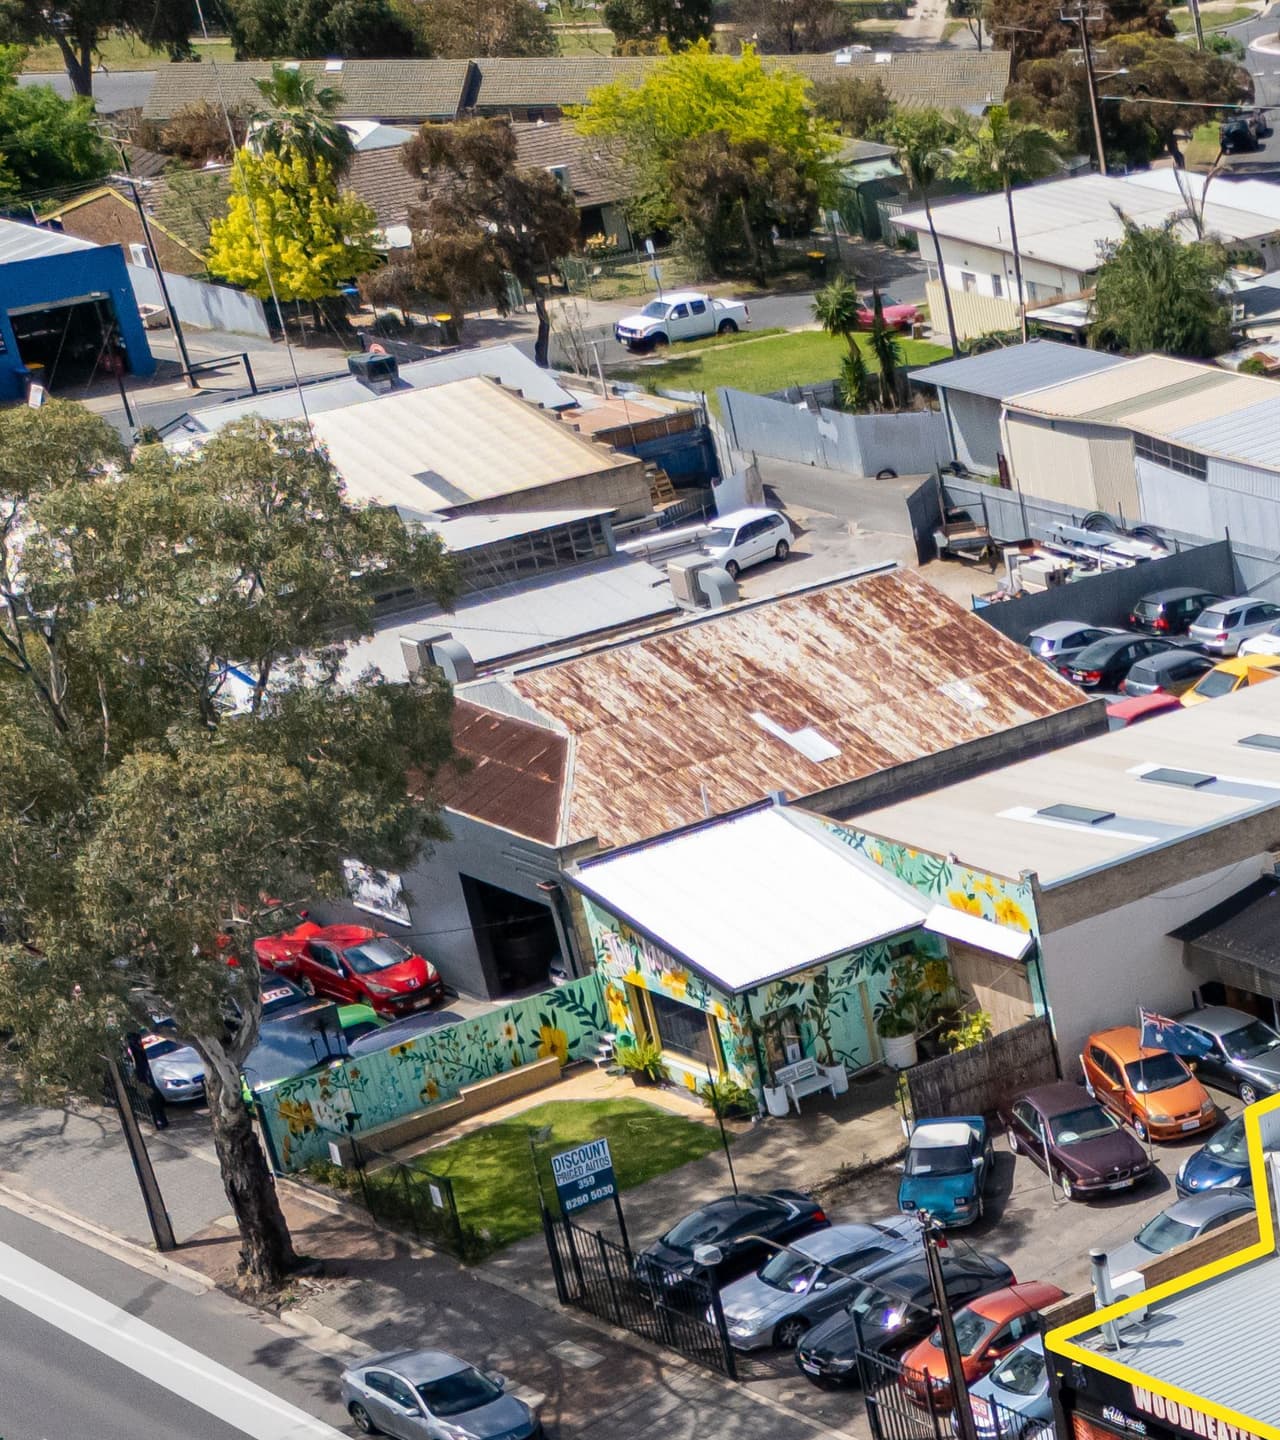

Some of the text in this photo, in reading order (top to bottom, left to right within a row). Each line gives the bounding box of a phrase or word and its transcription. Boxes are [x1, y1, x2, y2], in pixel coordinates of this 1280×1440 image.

[553, 1140, 607, 1173] DISCOUNT
[557, 1156, 610, 1185] PRICED AUTOS
[577, 1176, 595, 1189] 359
